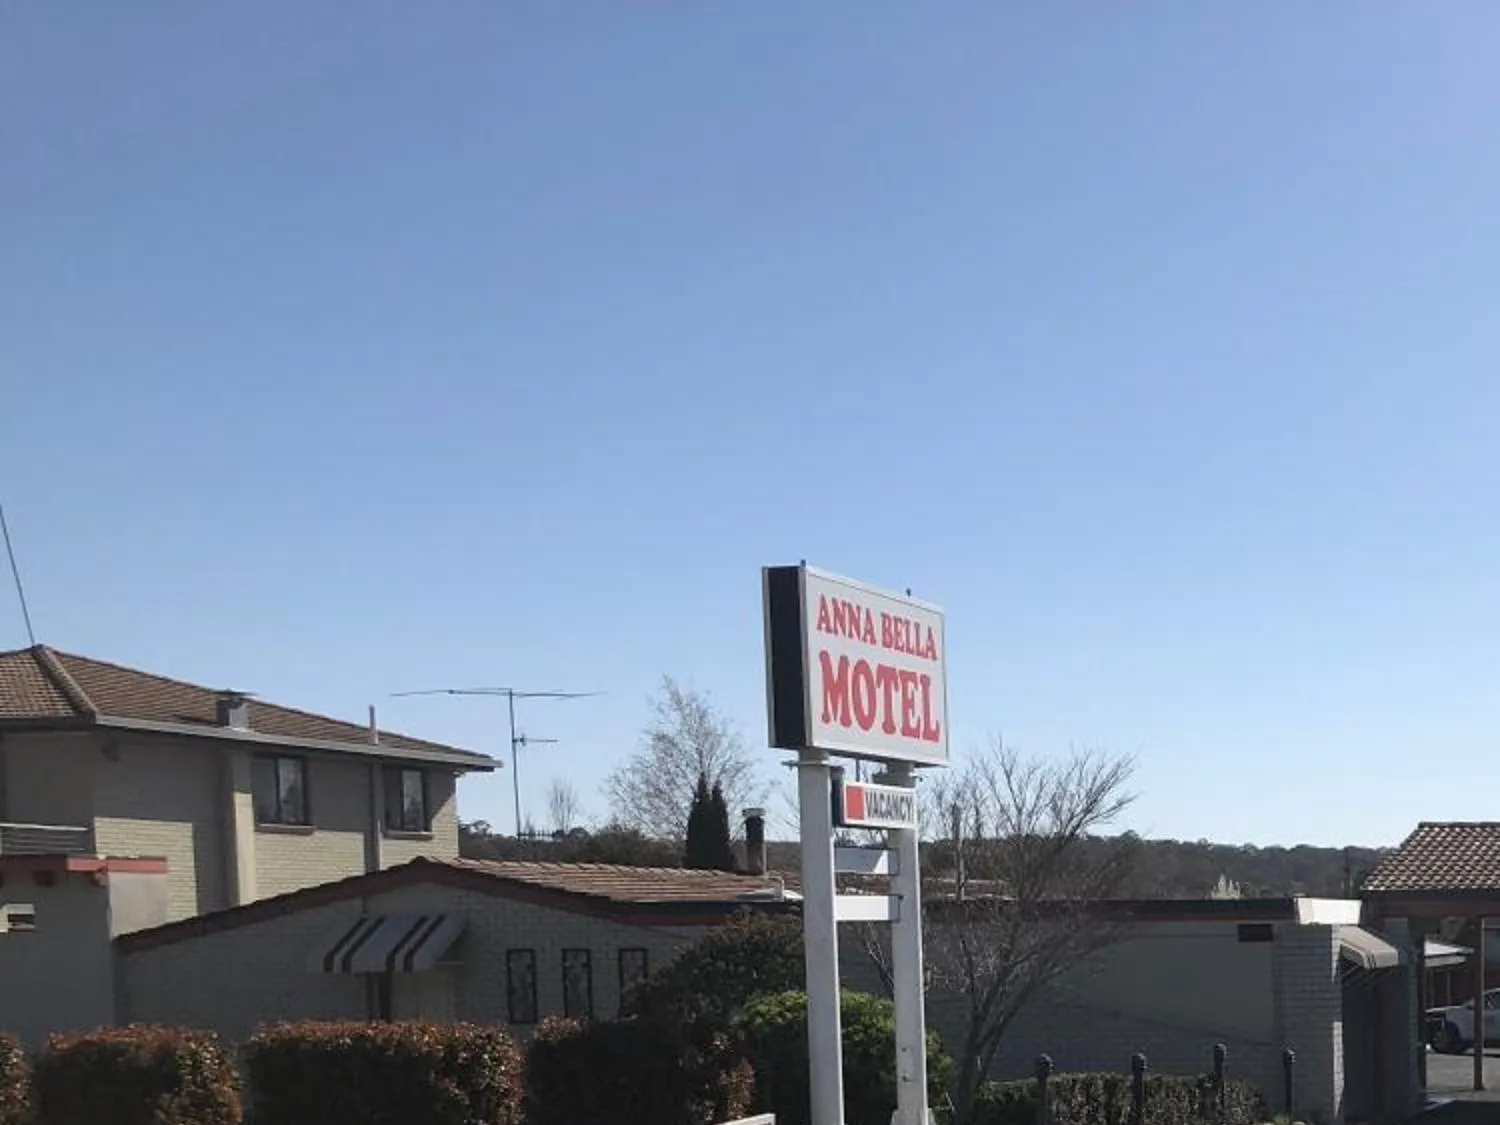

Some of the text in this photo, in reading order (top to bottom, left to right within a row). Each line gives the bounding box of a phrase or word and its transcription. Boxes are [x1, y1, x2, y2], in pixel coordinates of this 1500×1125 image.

[817, 595, 937, 660] ANNA BELLA
[820, 651, 940, 742] MOTEL
[865, 791, 914, 822] VACANCY
